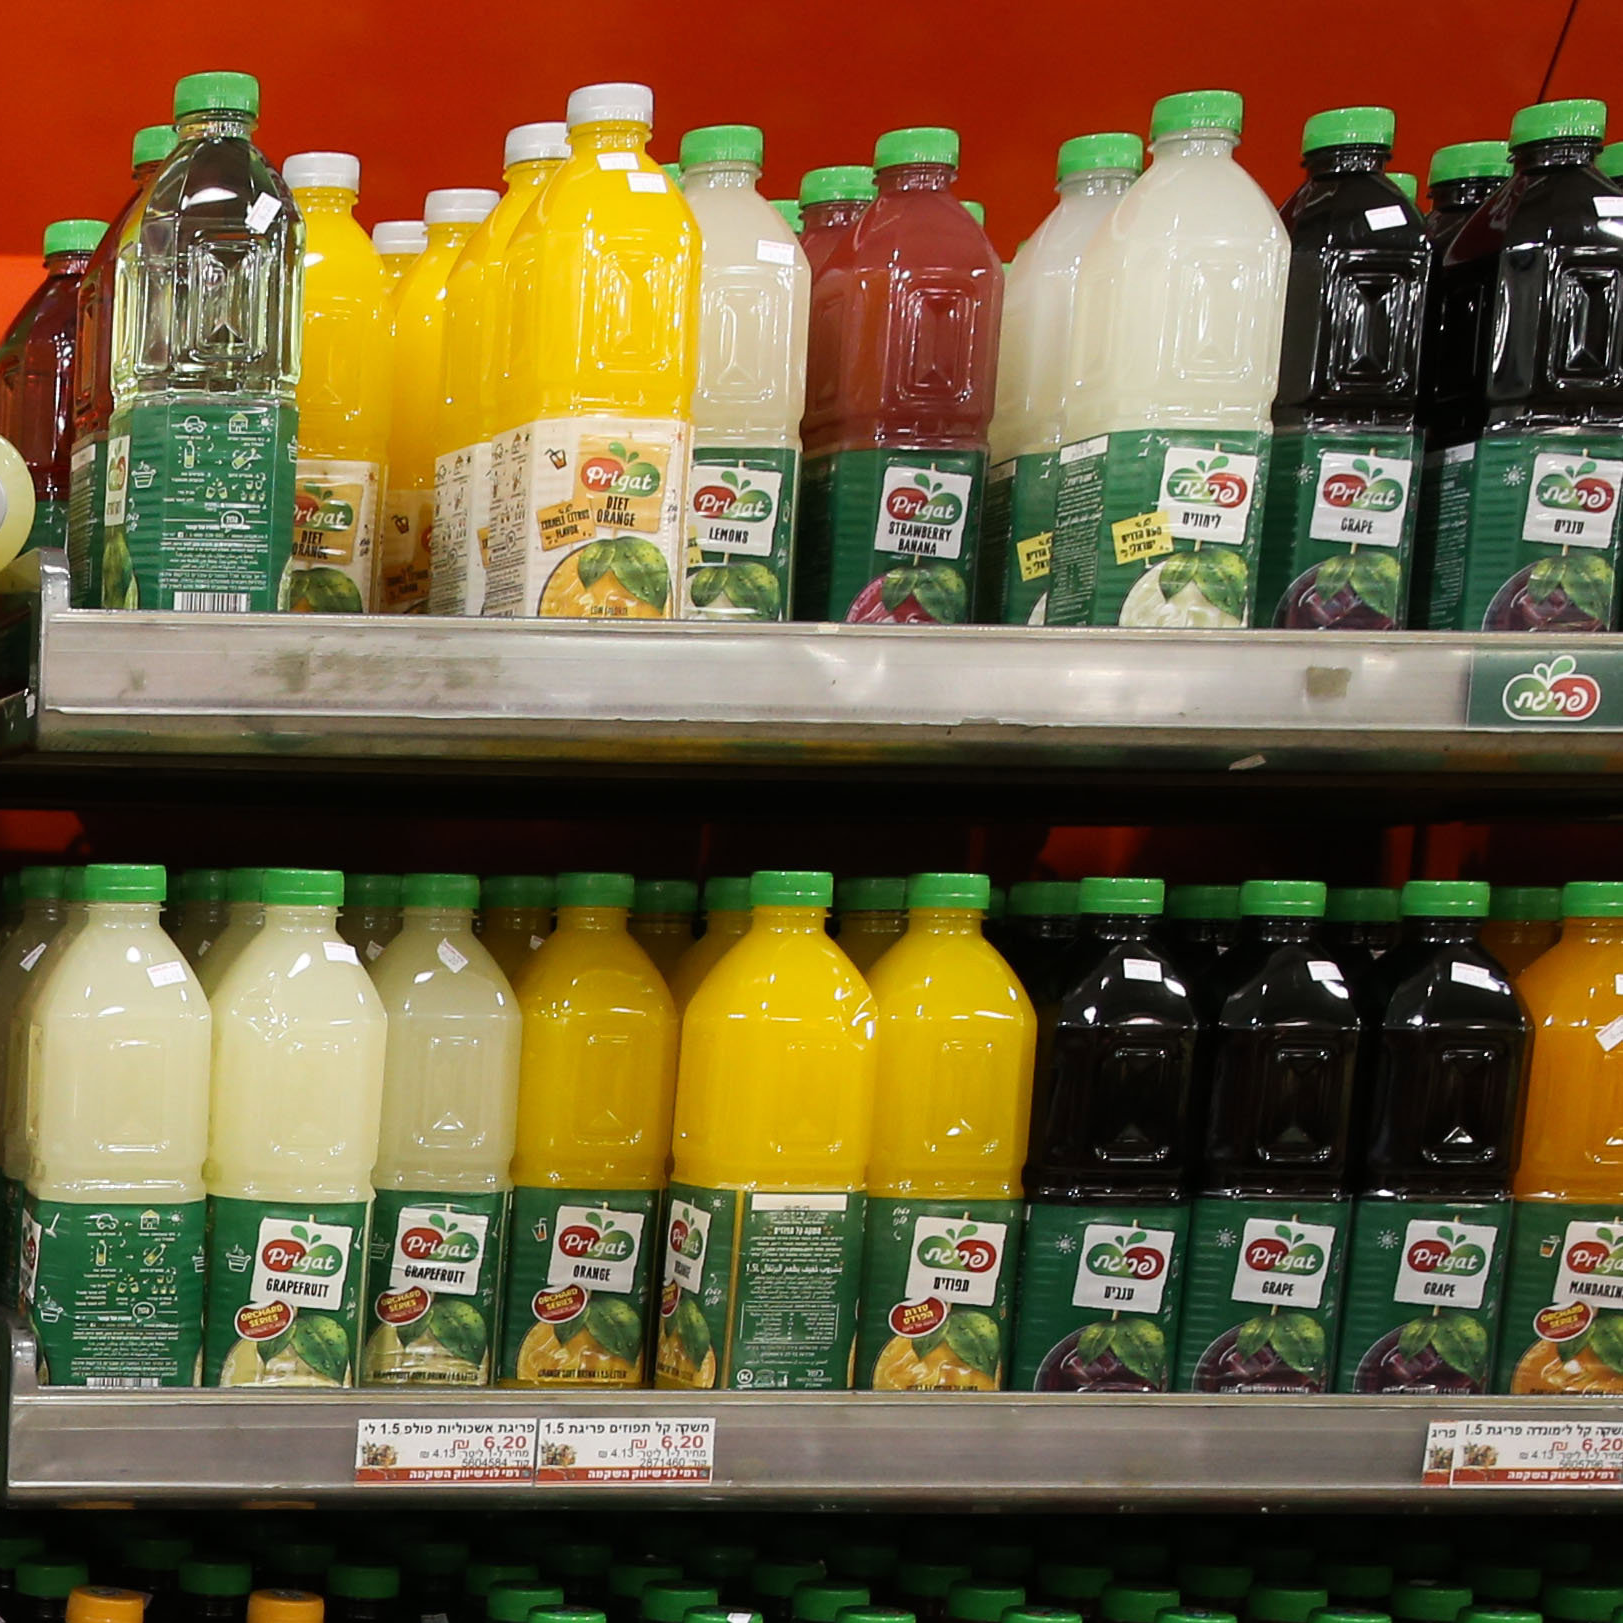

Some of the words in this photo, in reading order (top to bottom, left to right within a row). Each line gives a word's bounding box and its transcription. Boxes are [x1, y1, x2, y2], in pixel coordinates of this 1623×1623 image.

[606, 496, 630, 510] DIET
[1329, 482, 1396, 508] Prigat
[597, 509, 636, 527] ORANGE
[1340, 518, 1374, 534] GRAPE
[709, 527, 749, 544] LEMONS
[889, 523, 952, 541] STRAWBERRY
[898, 538, 937, 556] BANANA
[1514, 686, 1588, 713] פריגת
[268, 1246, 336, 1273] Prigat
[1250, 1247, 1317, 1271] Prigat
[1412, 1248, 1478, 1271] Prigat
[404, 1264, 466, 1284] GRAPEFRUIT
[571, 1264, 612, 1282] ORANGE
[265, 1278, 329, 1300] GRAPEFRUIT
[1261, 1280, 1295, 1297] GRAPE
[1423, 1280, 1457, 1297] GRAPE
[610, 1423, 651, 1434] תפוזים
[484, 1436, 526, 1449] 6.20
[661, 1436, 704, 1449] 6.20
